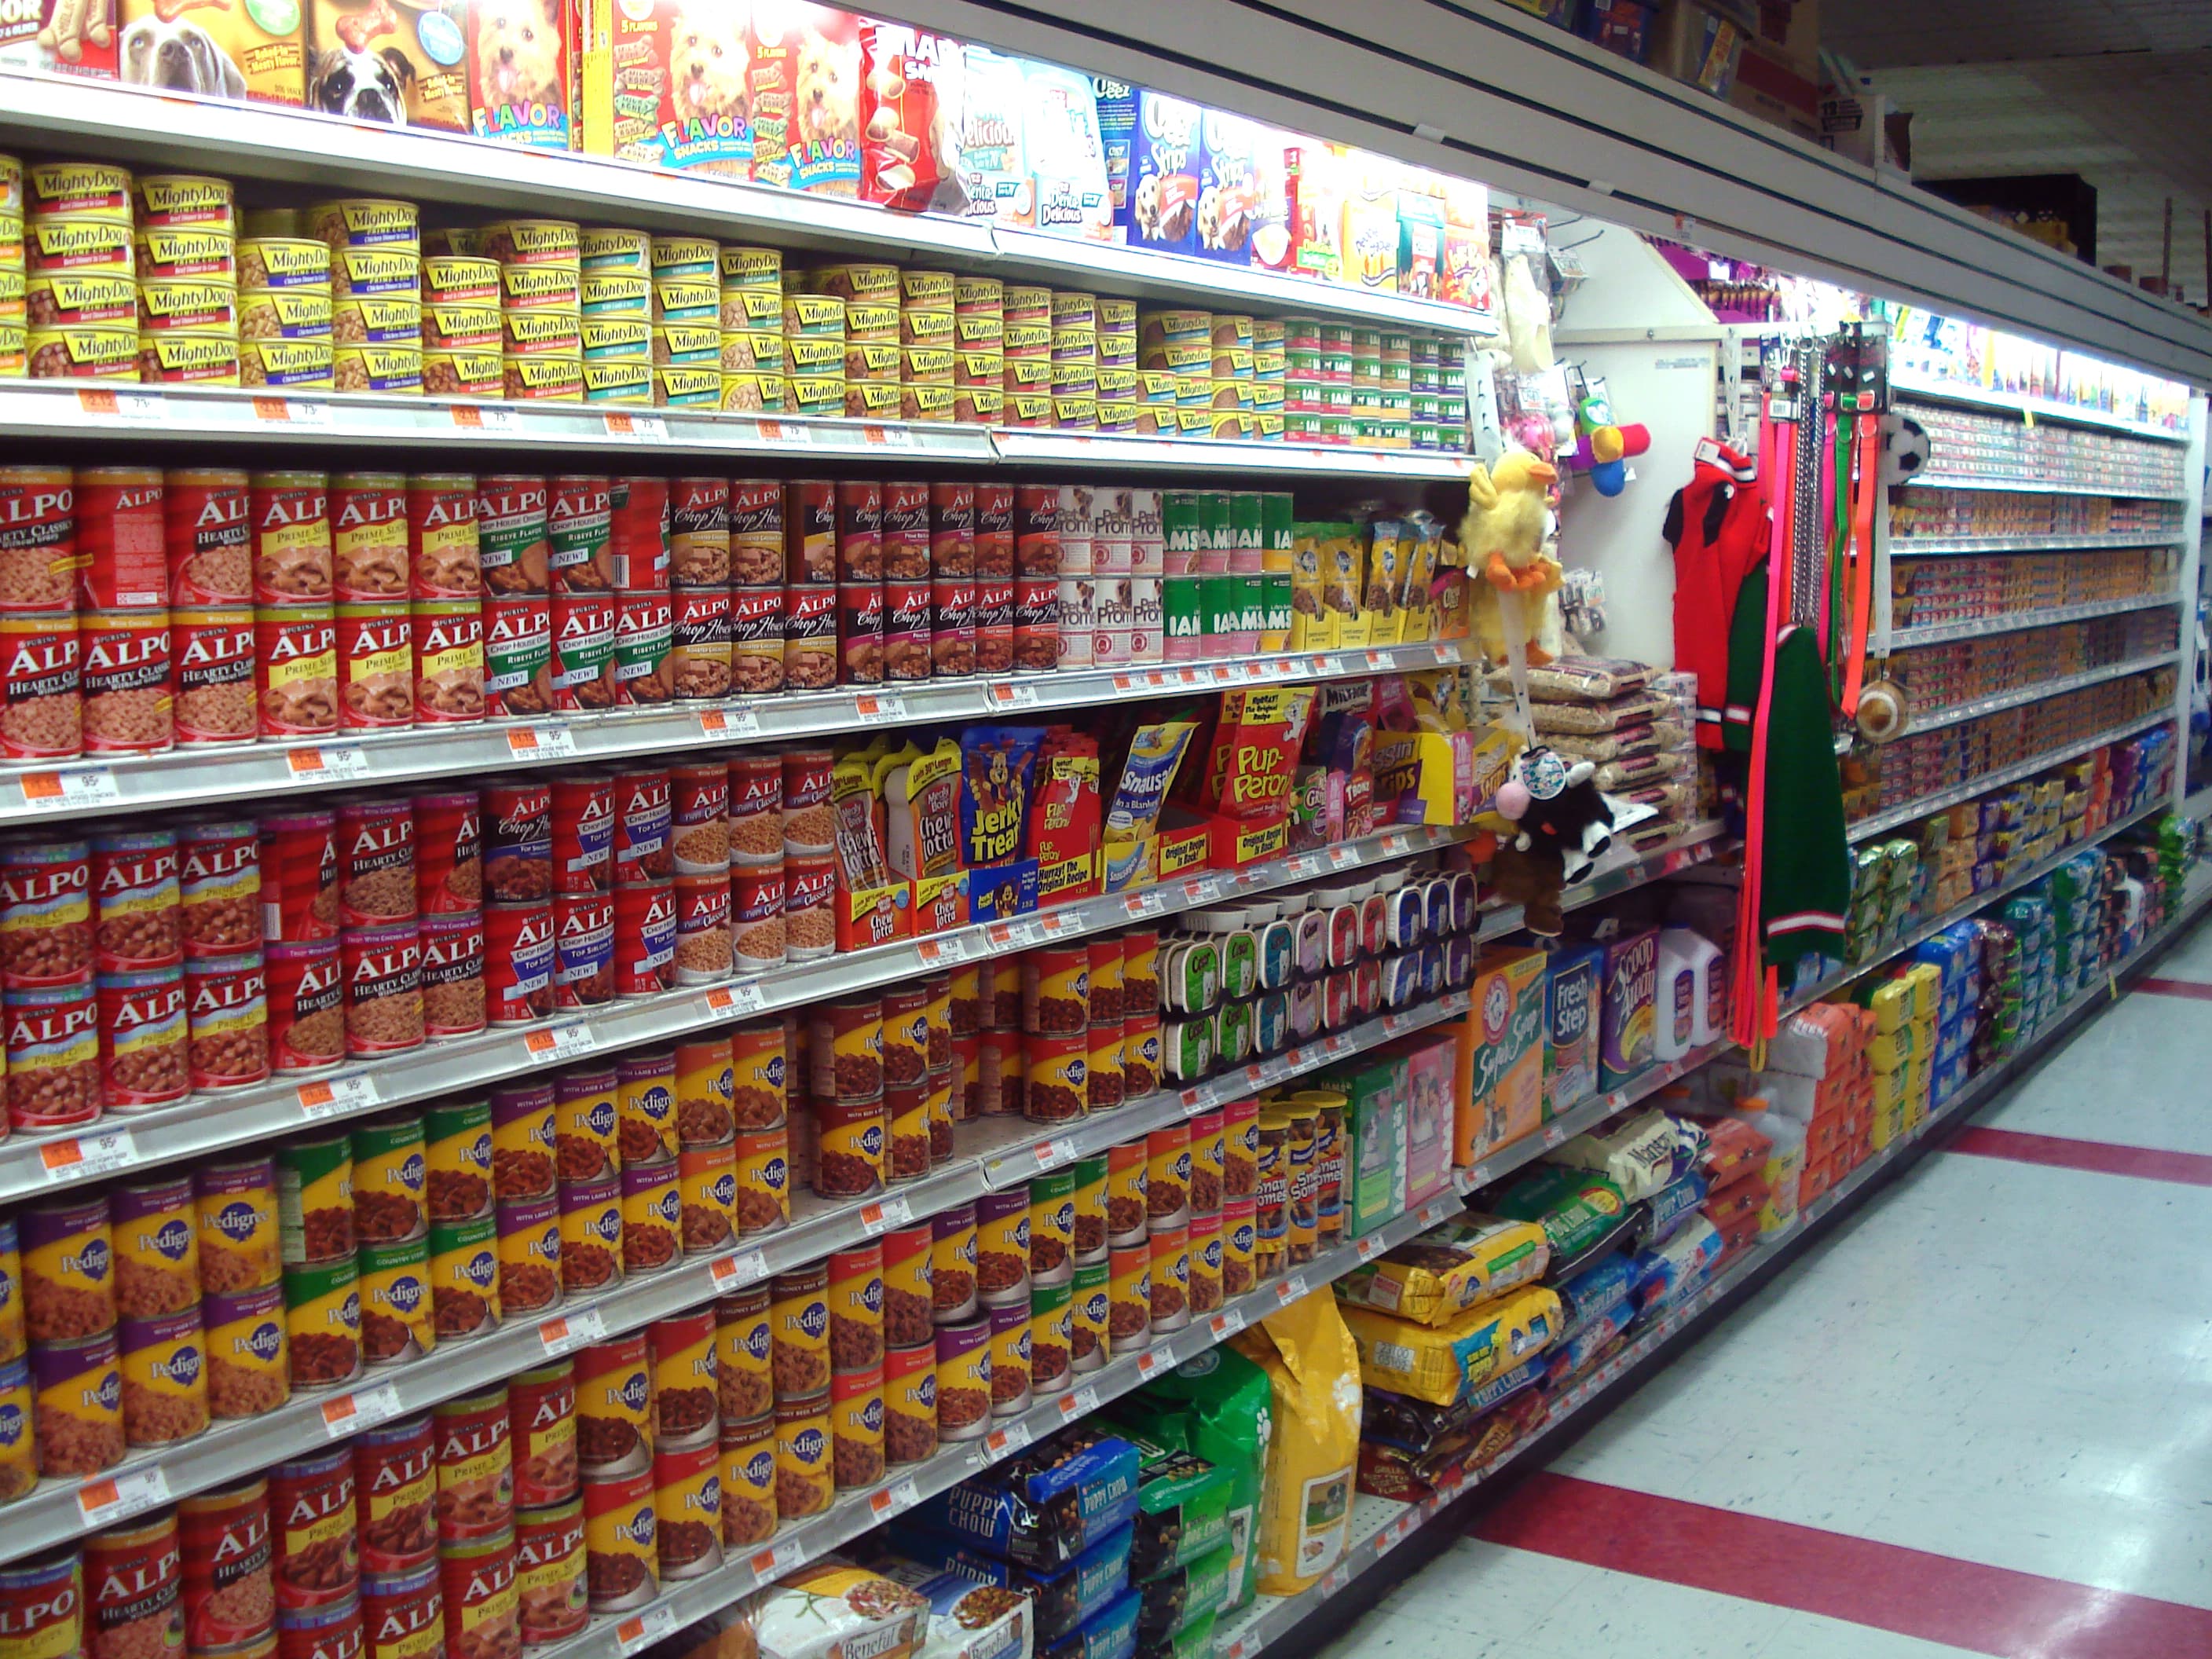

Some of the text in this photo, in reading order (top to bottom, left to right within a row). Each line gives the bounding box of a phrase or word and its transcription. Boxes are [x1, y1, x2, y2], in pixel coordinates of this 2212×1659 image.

[472, 101, 561, 137] FLAVOR
[661, 114, 747, 148] FLAVOR
[674, 140, 719, 159] SNACKS
[789, 137, 855, 167] FLAVOR
[799, 162, 834, 179] SNACKS
[1042, 206, 1082, 225] Delicious
[116, 489, 163, 510] ALPO
[476, 489, 547, 517] ALPO
[687, 487, 729, 507] ALPO
[737, 489, 780, 507] ALPO
[1104, 511, 1118, 522] Pet
[199, 529, 241, 544] HEARTY
[277, 530, 309, 544] PRIME
[351, 529, 383, 544] PRIME
[558, 551, 584, 564] NEW!
[504, 607, 529, 617] PURINA
[628, 601, 653, 611] PURINA
[683, 598, 729, 618] ALPO
[738, 596, 782, 614] ALPO
[797, 595, 836, 613] ALPO
[1061, 600, 1081, 613] Pet
[1105, 599, 1120, 612] Pet
[438, 617, 465, 627] PURINA
[100, 632, 132, 644] PURINA
[490, 640, 534, 654] CHOP HOUSE
[632, 646, 656, 657] RIBEYE
[438, 652, 467, 666] PRIME
[507, 654, 534, 665] RIBEYE
[569, 668, 595, 681] NEW!
[623, 663, 648, 676] NEW!
[9, 676, 57, 694] HEARTY
[86, 672, 136, 689] HEARTY
[497, 673, 525, 687] NEW!
[1238, 746, 1284, 775] Pup-
[1233, 770, 1293, 803] Peroni
[1115, 798, 1124, 808] In
[972, 800, 1024, 837] Jerky
[1243, 827, 1281, 848] Original Recipe
[587, 848, 608, 862] NEW!
[636, 840, 659, 853] NEW!
[1165, 838, 1205, 859] Original Recipe
[1260, 840, 1276, 853] Back!
[354, 854, 396, 871] HEARTY
[1183, 851, 1199, 864] Back!
[1067, 862, 1077, 873] The
[1038, 877, 1064, 892] Original
[1064, 870, 1088, 885] Recipe
[575, 903, 599, 914] PURINA
[653, 952, 673, 964] NEW!
[570, 966, 594, 979] NEW!
[355, 980, 397, 997] HEARTY
[524, 979, 546, 991] NEW!
[1558, 973, 1588, 1009] Fresh
[9, 1002, 97, 1046] ALPO
[1557, 1005, 1587, 1037] Step
[947, 1485, 1003, 1519] PUPPY
[1084, 1477, 1128, 1514] PUPPY CHOW
[948, 1509, 994, 1538] CHOW
